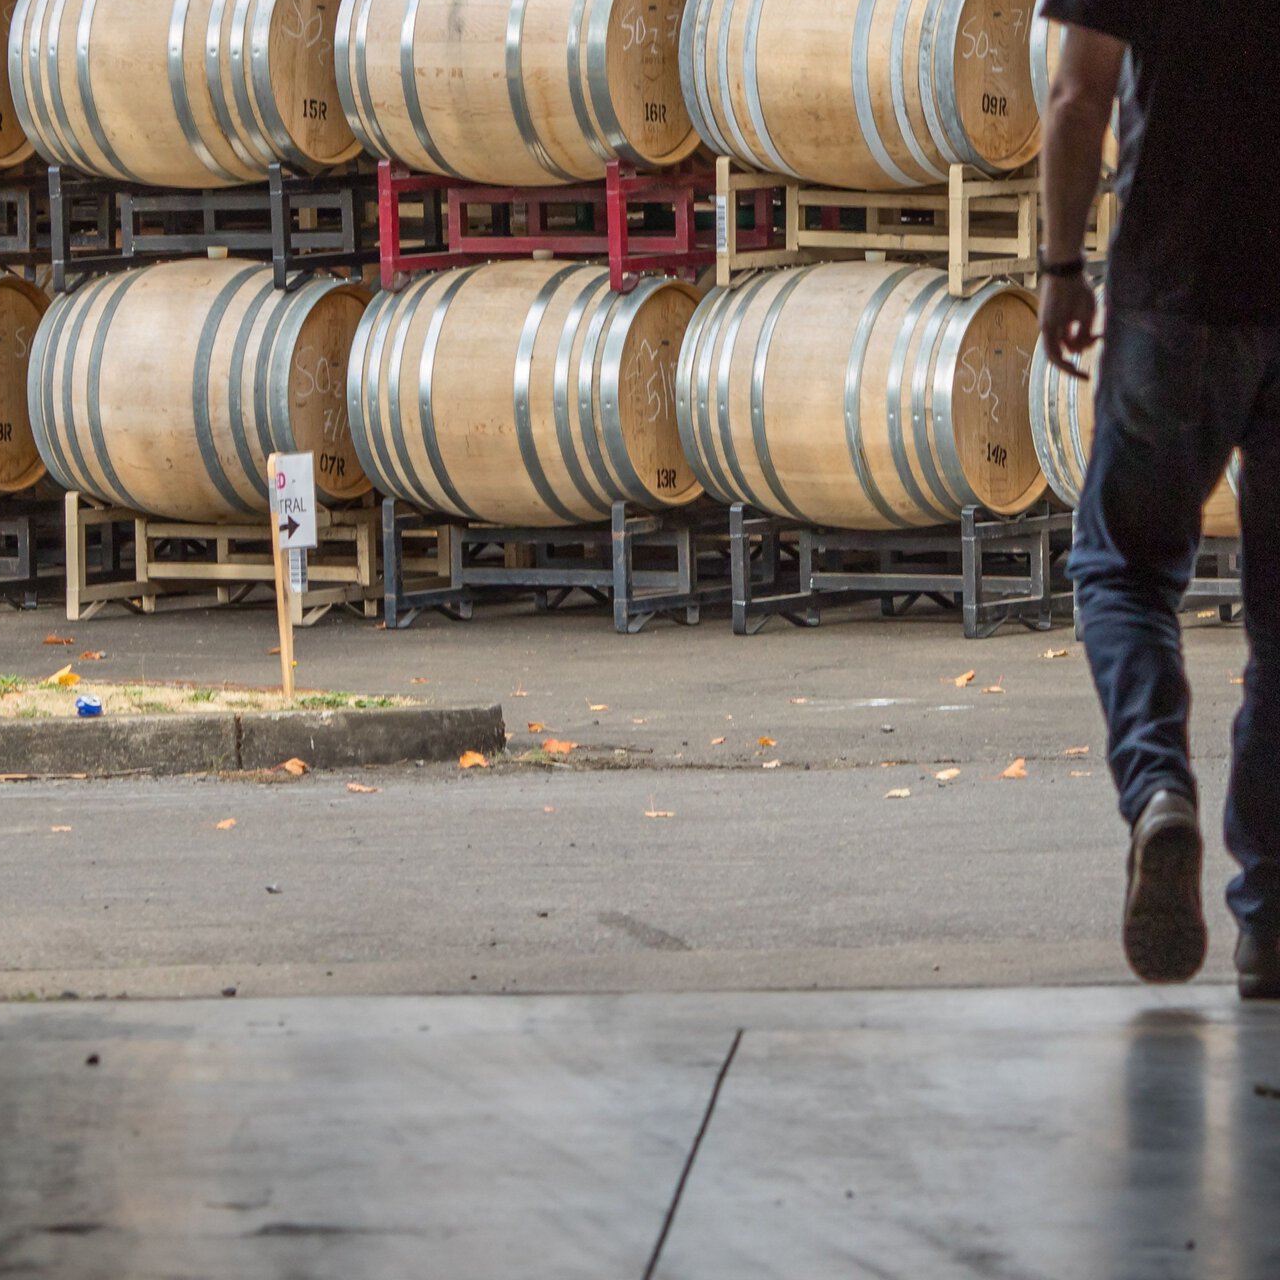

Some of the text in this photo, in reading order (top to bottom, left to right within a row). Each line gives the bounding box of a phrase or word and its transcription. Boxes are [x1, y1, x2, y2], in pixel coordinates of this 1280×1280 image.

[302, 99, 328, 120] 15R
[981, 93, 1008, 117] 09R
[319, 452, 345, 477] 07R
[987, 441, 1008, 468] 14R
[657, 468, 677, 489] 13R
